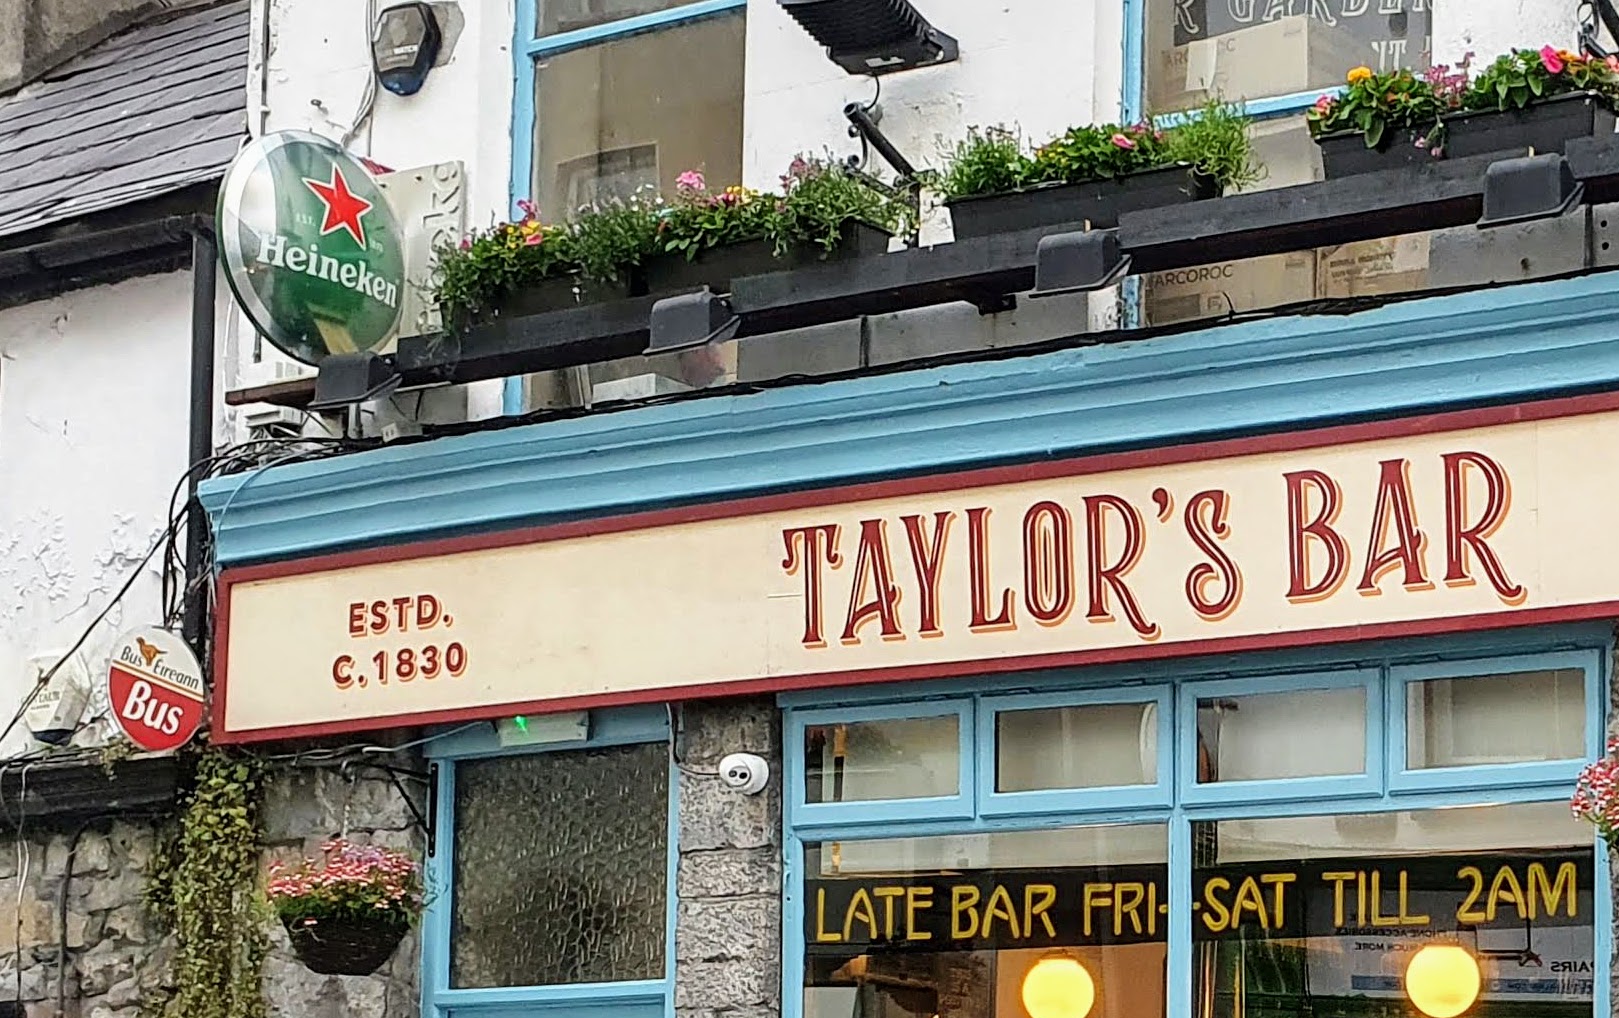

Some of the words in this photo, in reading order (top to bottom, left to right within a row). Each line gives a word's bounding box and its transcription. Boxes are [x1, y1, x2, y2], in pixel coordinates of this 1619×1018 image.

[256, 233, 398, 309] Heineken
[1154, 264, 1234, 288] ARCOROC
[782, 486, 1245, 648] TAYLOR'S
[1283, 450, 1528, 605] BAR
[349, 594, 454, 638] ESTD.
[121, 645, 144, 667] Bus
[332, 641, 468, 690] C.1830
[121, 680, 184, 735] Bus
[816, 886, 934, 942] LATE
[952, 884, 1057, 940] BAR
[1321, 869, 1431, 928] TILL
[1456, 861, 1578, 926] 2AM
